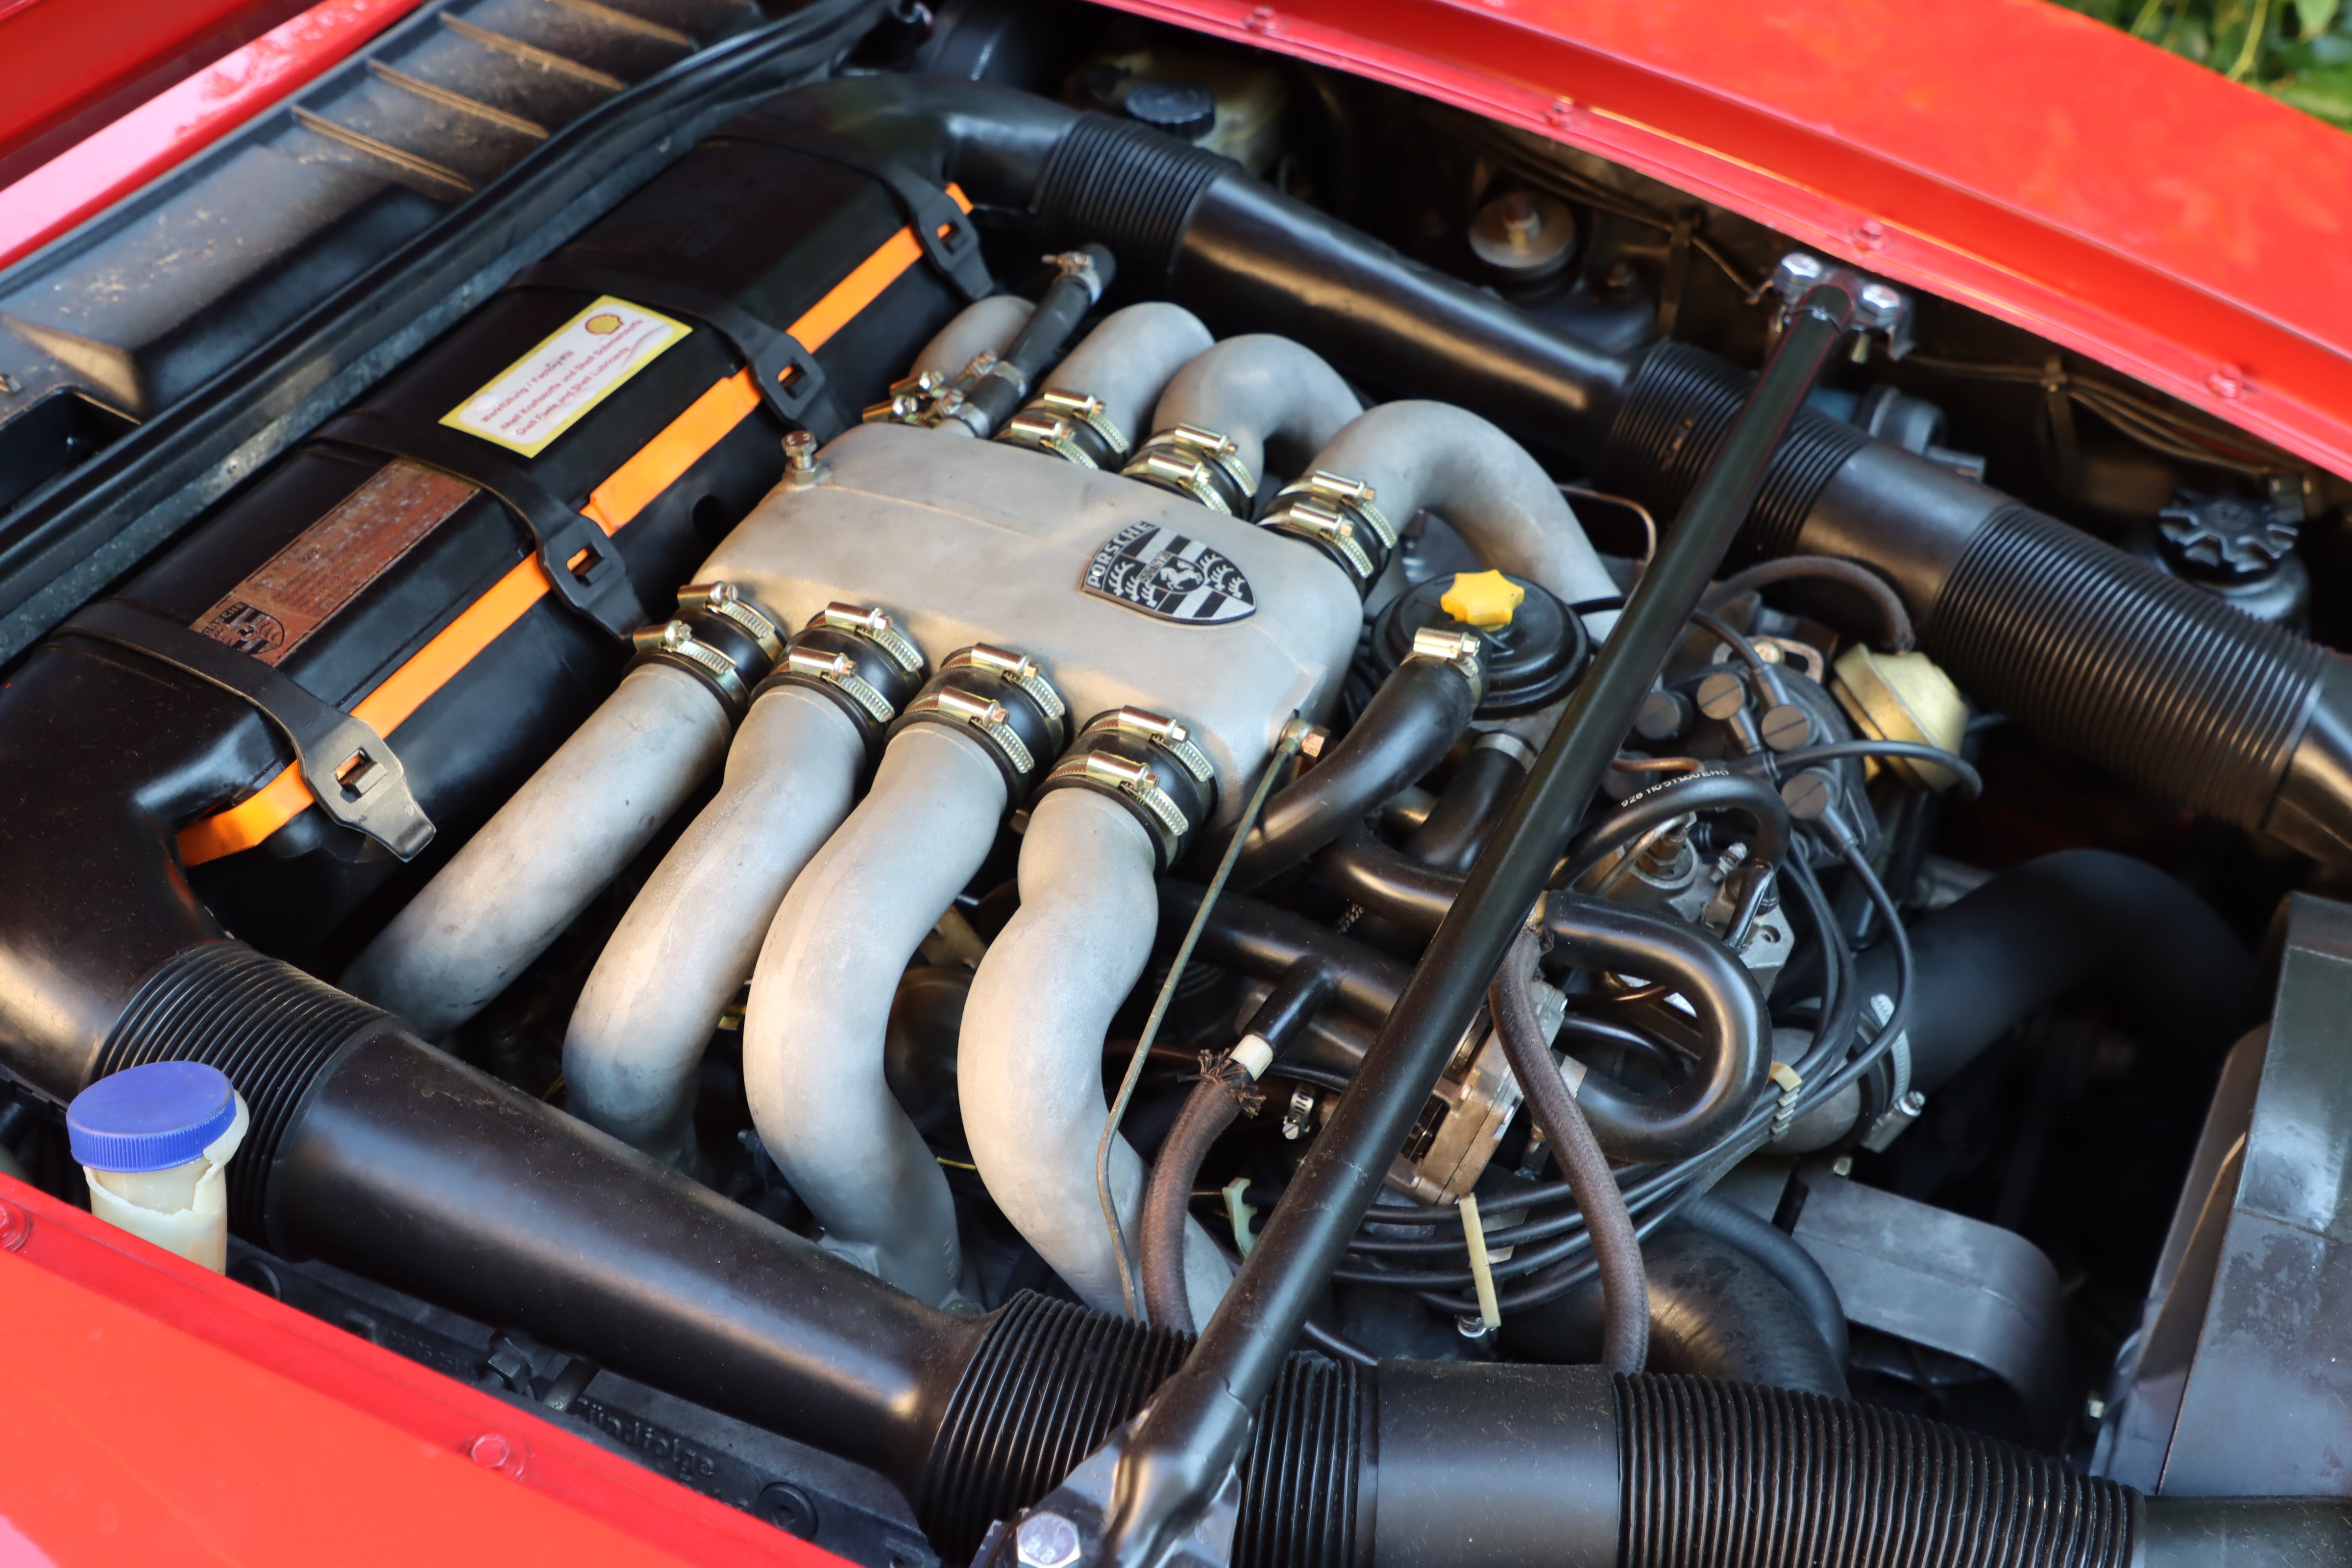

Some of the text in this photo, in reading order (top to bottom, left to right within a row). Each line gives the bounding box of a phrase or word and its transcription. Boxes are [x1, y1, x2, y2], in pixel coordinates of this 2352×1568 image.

[500, 415, 522, 429] Shell
[520, 383, 562, 414] Kraftstoffe
[562, 370, 577, 383] und
[574, 356, 595, 370] Shell
[515, 347, 631, 435] Shell Fuels and Shell Lubricants
[1086, 520, 1156, 588] PORSCHE
[1621, 792, 1643, 808] 928
